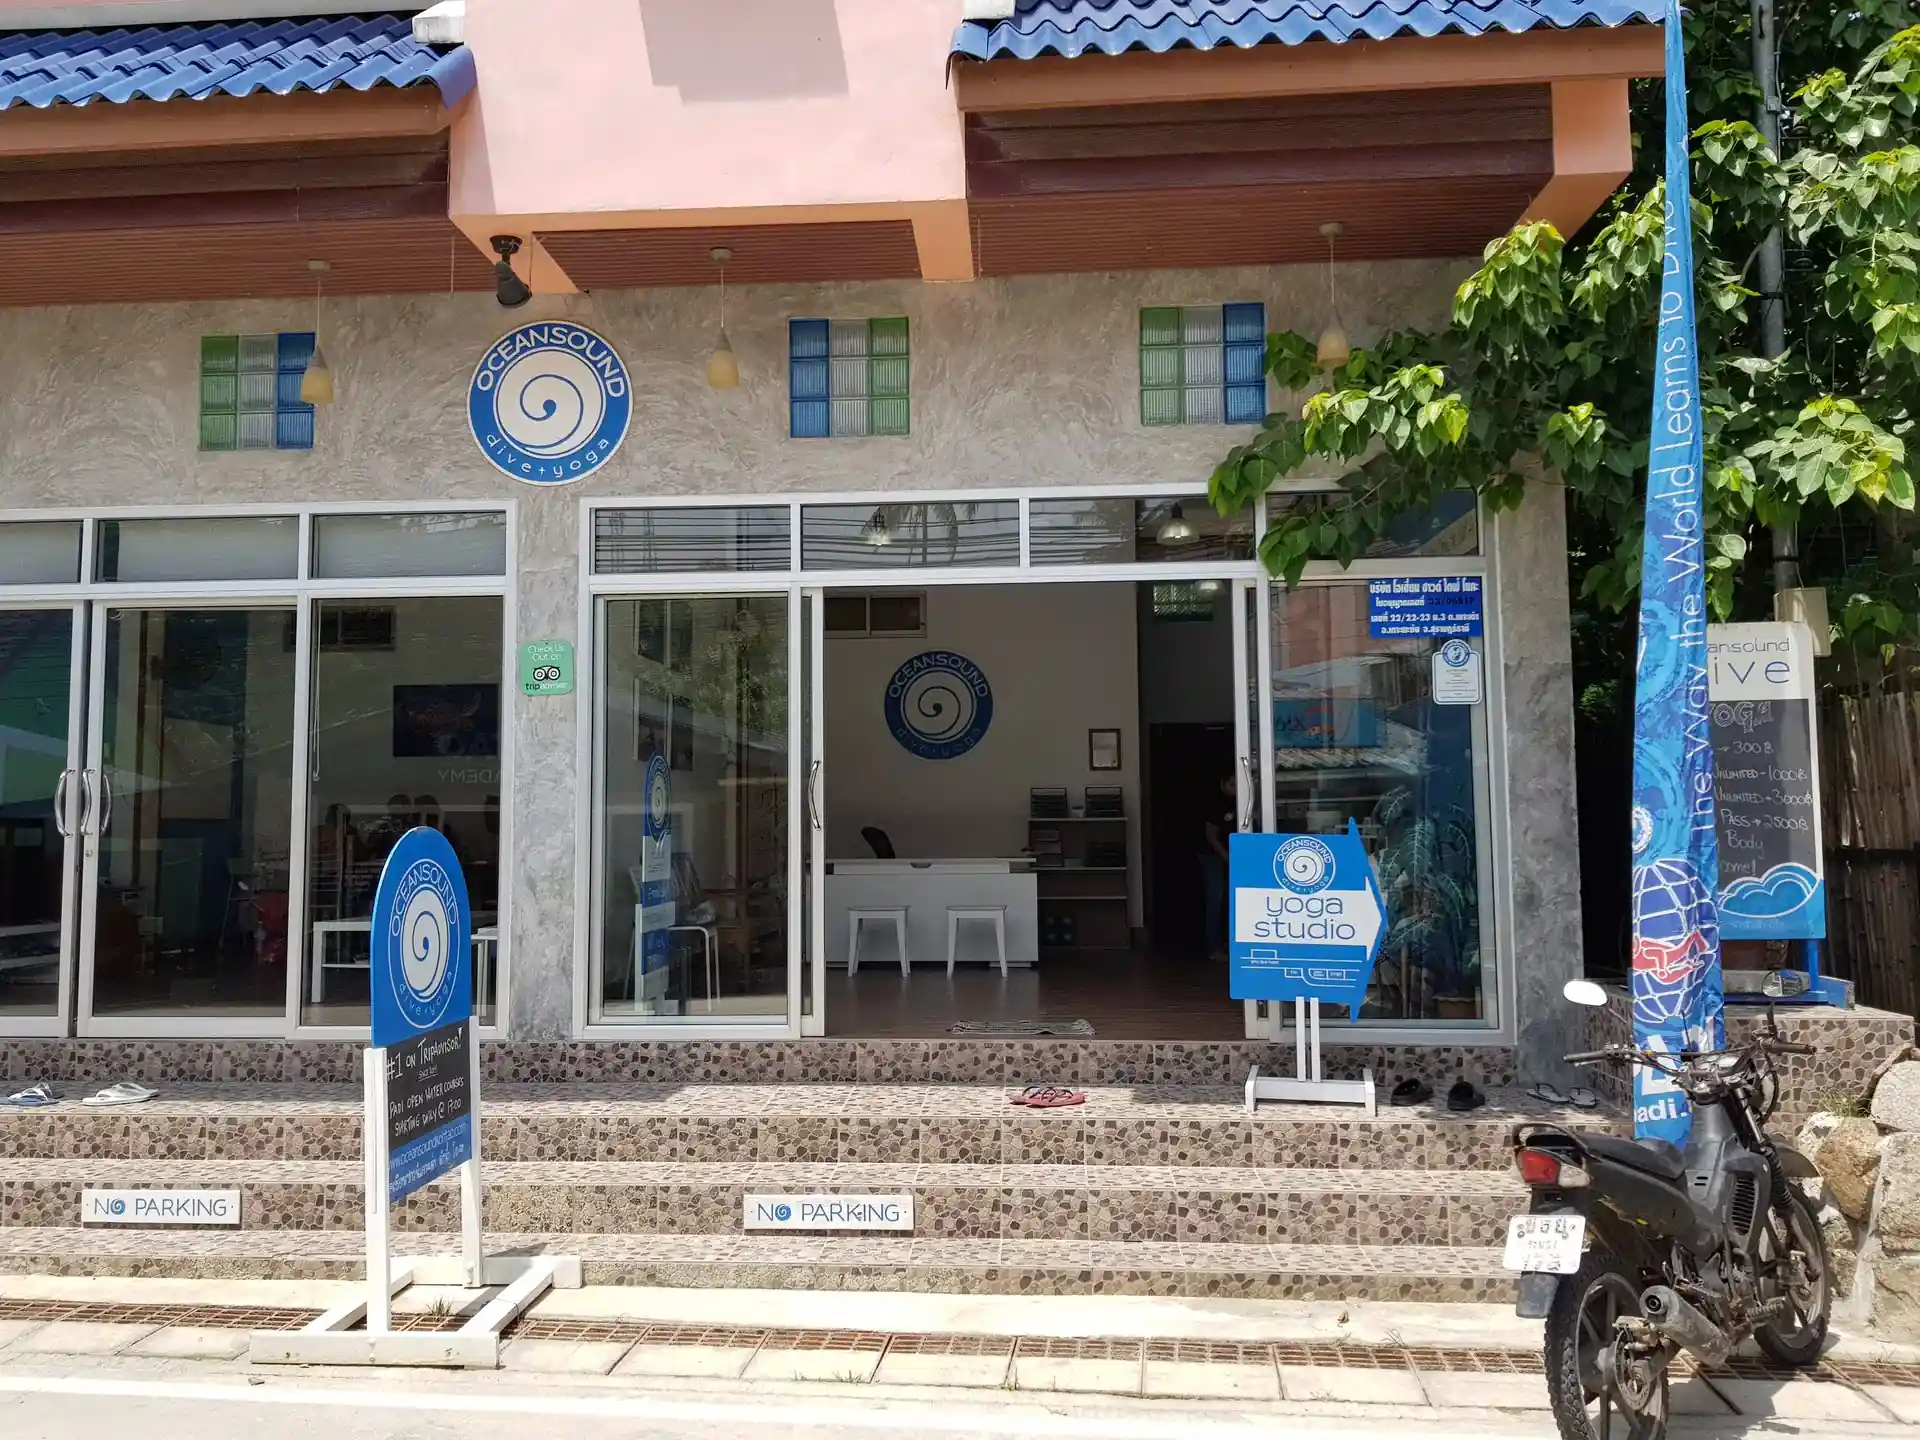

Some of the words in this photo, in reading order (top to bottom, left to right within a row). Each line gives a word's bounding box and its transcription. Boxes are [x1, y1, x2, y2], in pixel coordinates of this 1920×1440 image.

[1659, 292, 1684, 327] to
[477, 326, 625, 397] OCEANSOUND
[1654, 336, 1693, 452] Learns
[1652, 464, 1701, 583] World
[1669, 593, 1704, 649] the
[1707, 638, 1790, 653] ansound
[889, 654, 988, 698] OCEANSOUND
[1714, 656, 1790, 684] ive
[1277, 839, 1332, 864] OCEANSOUND
[391, 864, 457, 937] OCEANSOUND
[1266, 896, 1343, 918] yoga
[1254, 918, 1356, 940] studio
[386, 1052, 403, 1081] #1
[94, 1197, 126, 1215] NO
[135, 1198, 227, 1217] PARKING
[757, 1203, 792, 1221] NO
[801, 1203, 900, 1222] PARKING
